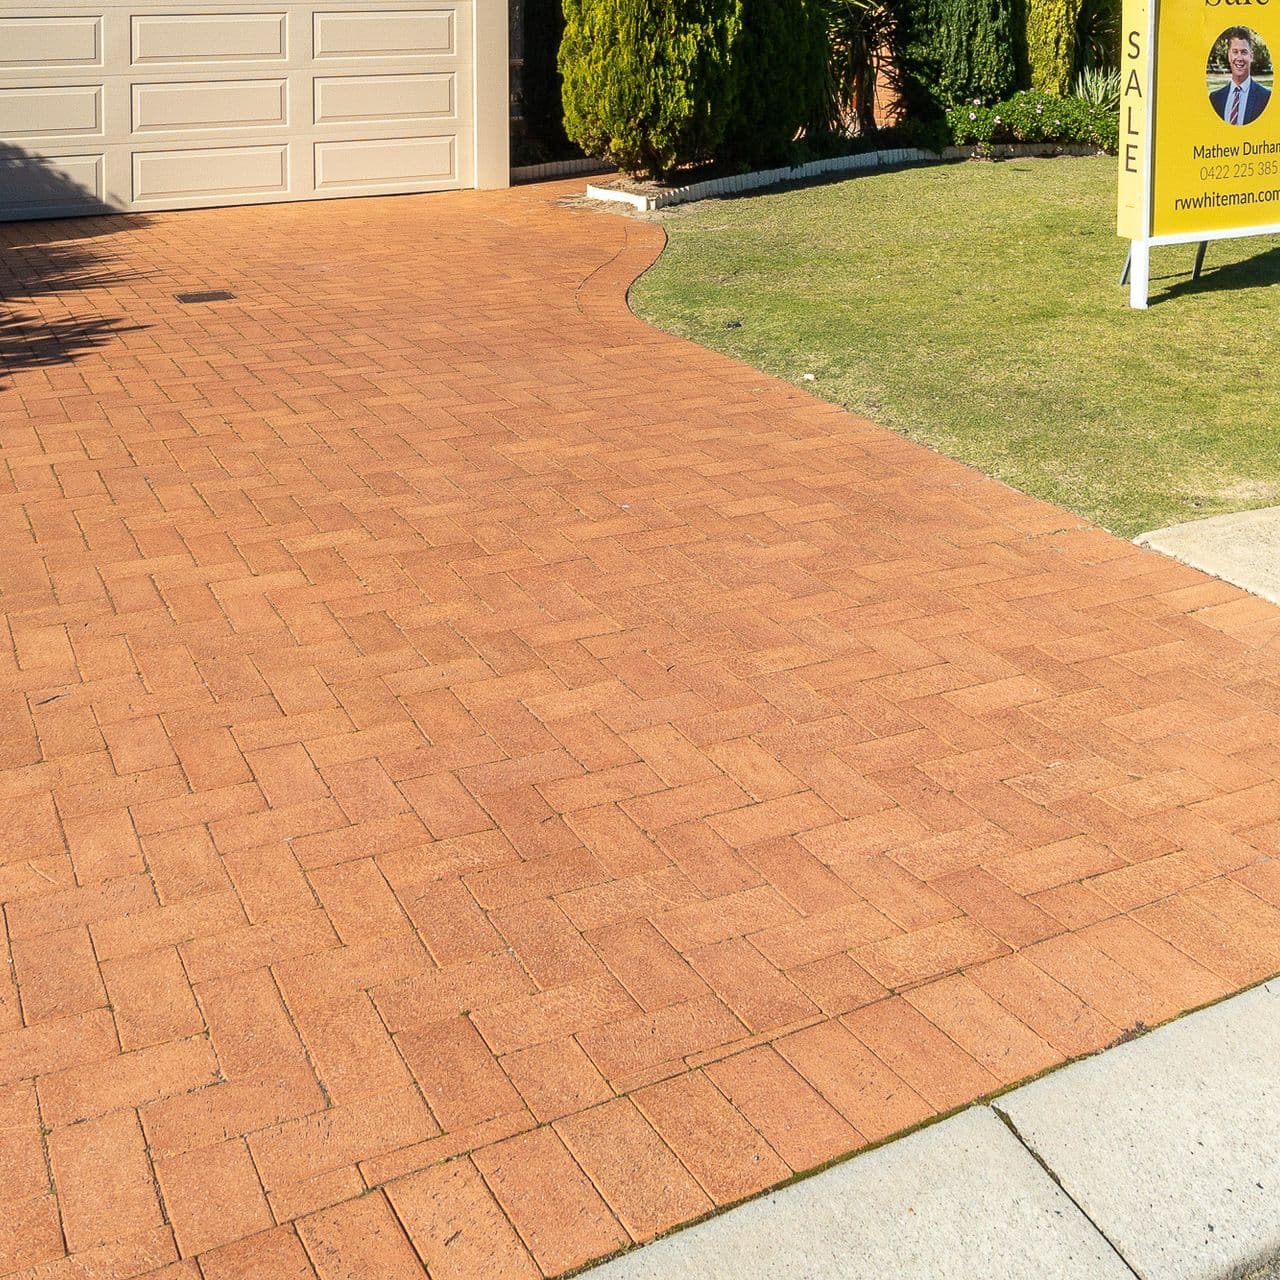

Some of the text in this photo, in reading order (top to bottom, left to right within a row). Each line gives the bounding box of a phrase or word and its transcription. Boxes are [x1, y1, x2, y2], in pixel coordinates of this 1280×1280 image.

[1124, 31, 1143, 173] SALE
[1193, 144, 1240, 160] Mathew
[1200, 160, 1279, 181] 0422 225 385
